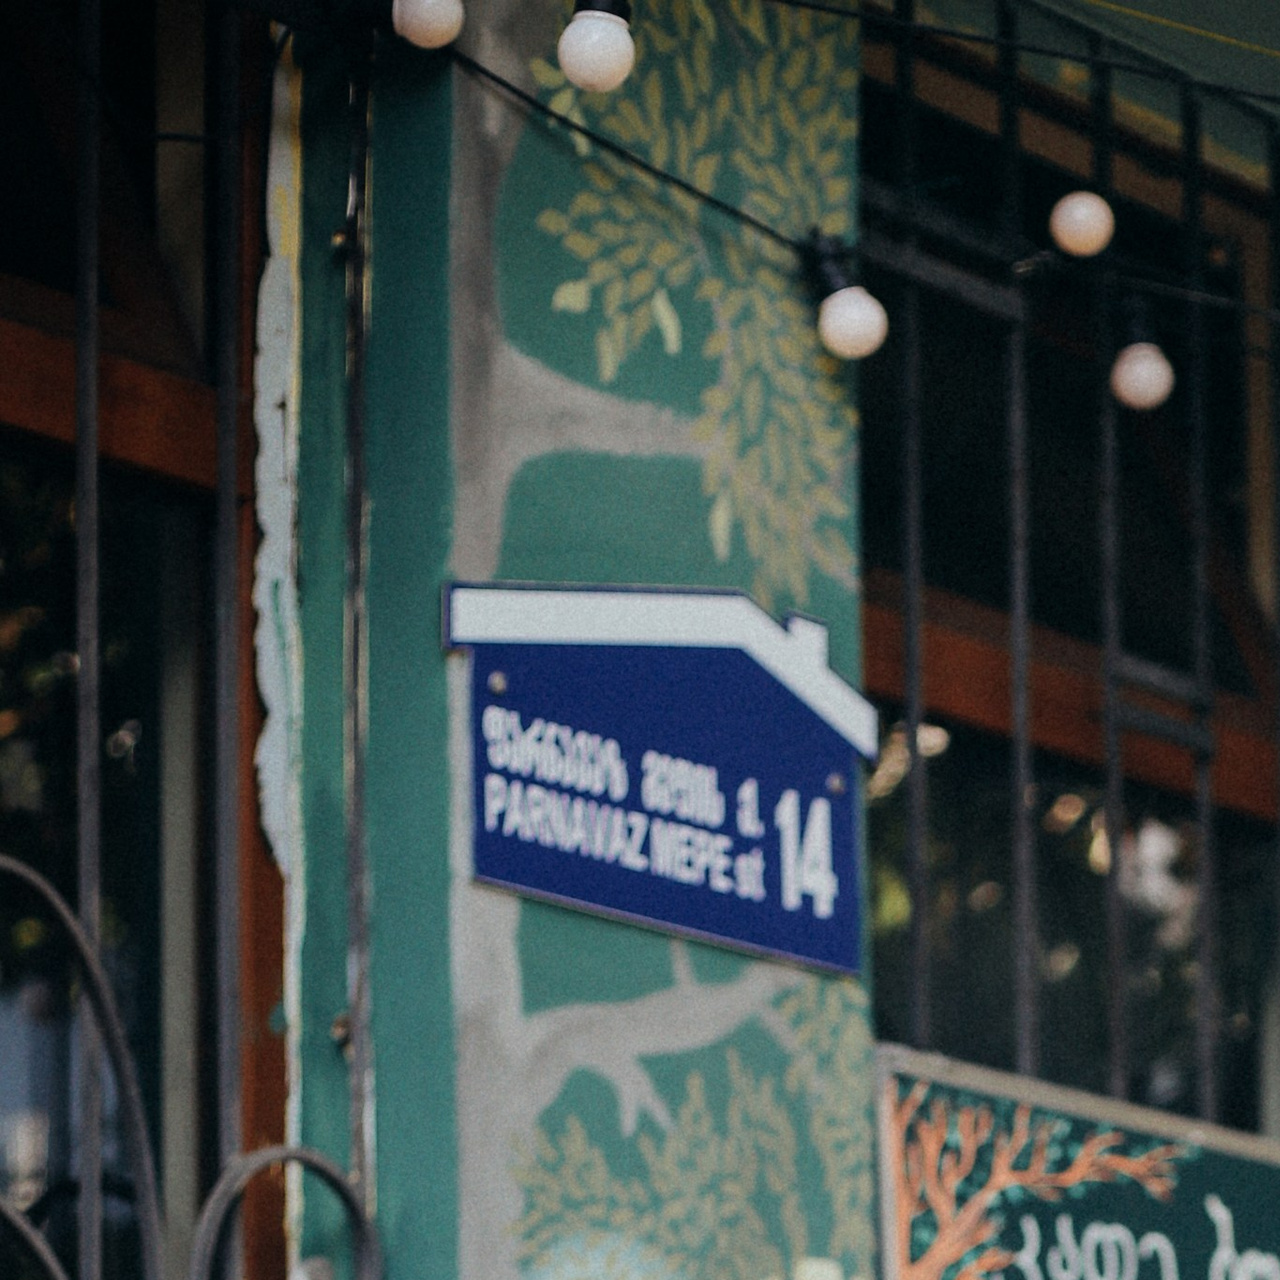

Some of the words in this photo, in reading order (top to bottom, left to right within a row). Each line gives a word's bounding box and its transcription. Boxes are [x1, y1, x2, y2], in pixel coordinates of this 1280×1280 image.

[484, 773, 650, 873] PARNAVAZ
[650, 817, 734, 894] MEPE
[775, 788, 840, 920] 14
